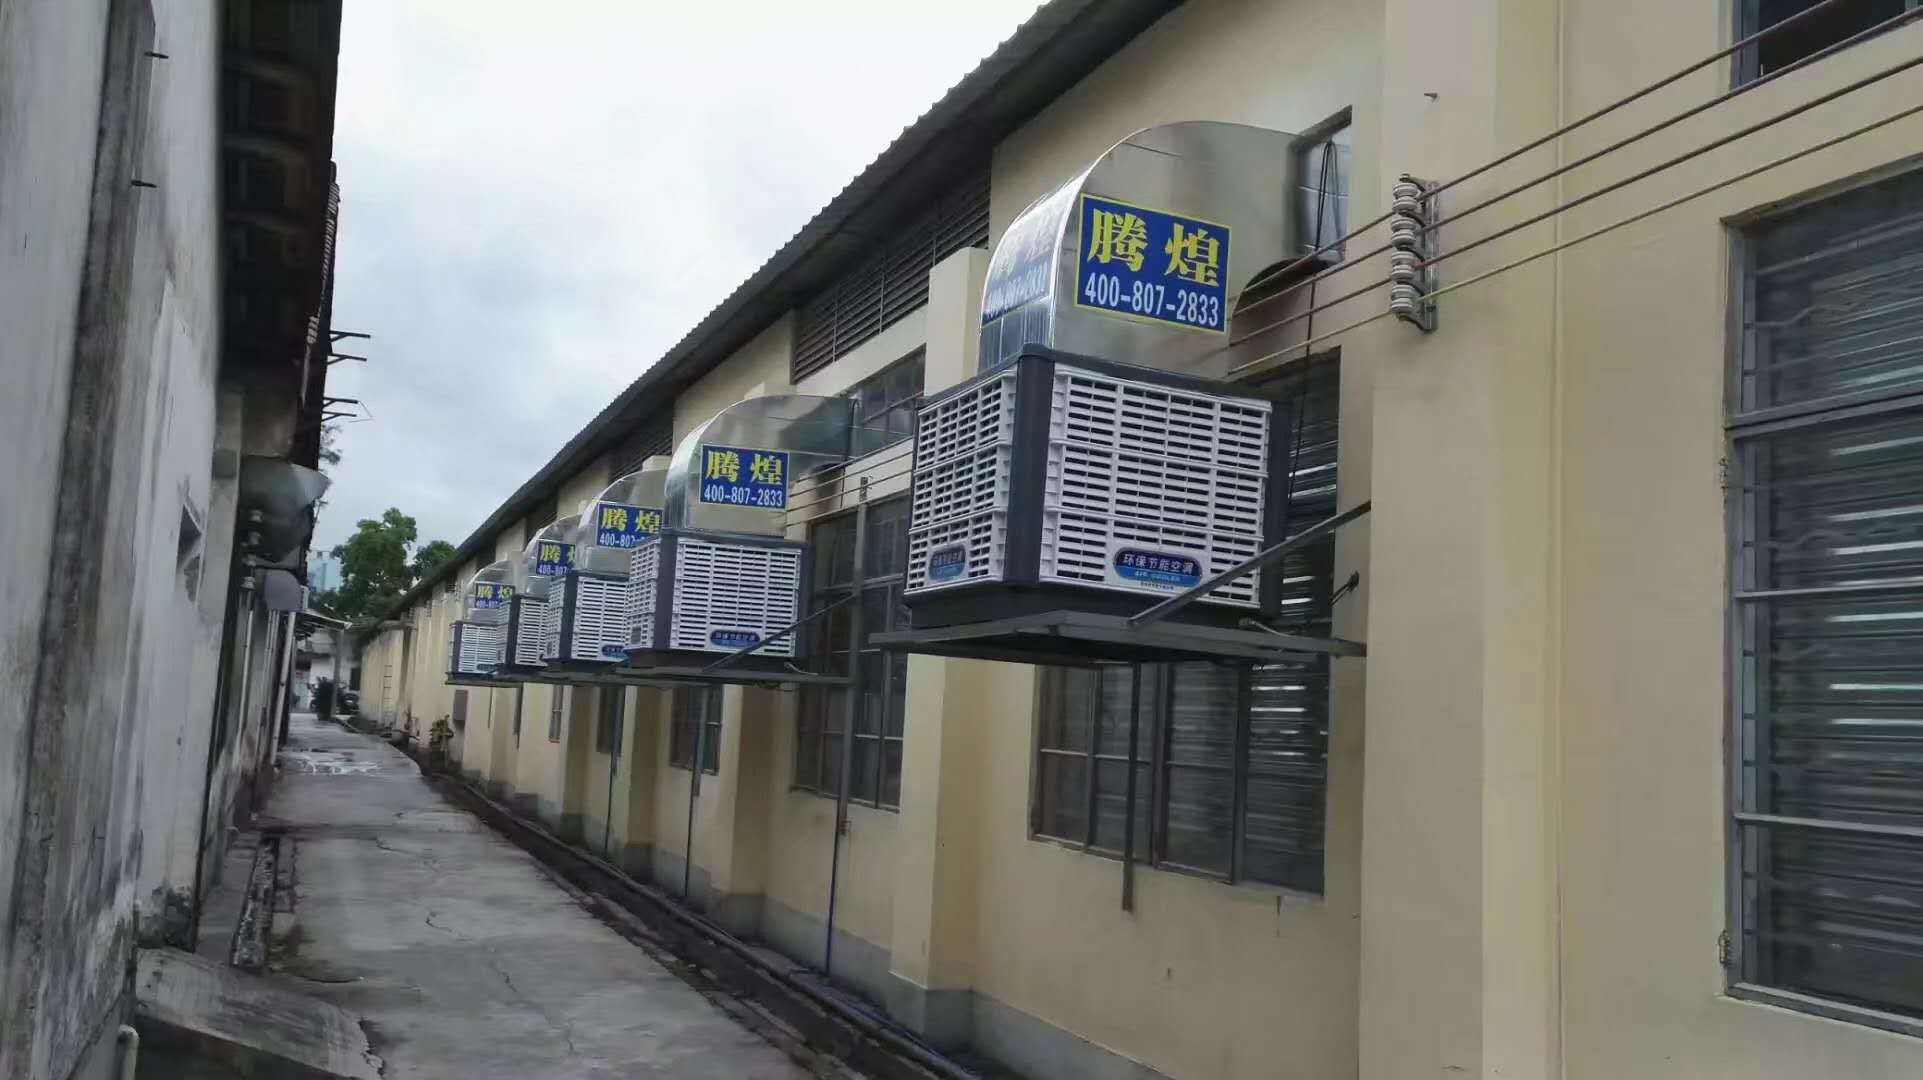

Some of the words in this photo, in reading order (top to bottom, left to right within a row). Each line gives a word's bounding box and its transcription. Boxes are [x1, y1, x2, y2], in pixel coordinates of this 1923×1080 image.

[1087, 208, 1220, 287] 腾煌
[1085, 272, 1219, 327] 400-807-2833
[705, 450, 783, 485] 腾煌
[704, 484, 783, 506] 400-807-2833
[601, 507, 660, 533] 腾煌
[1123, 553, 1194, 574] 环保节能空调
